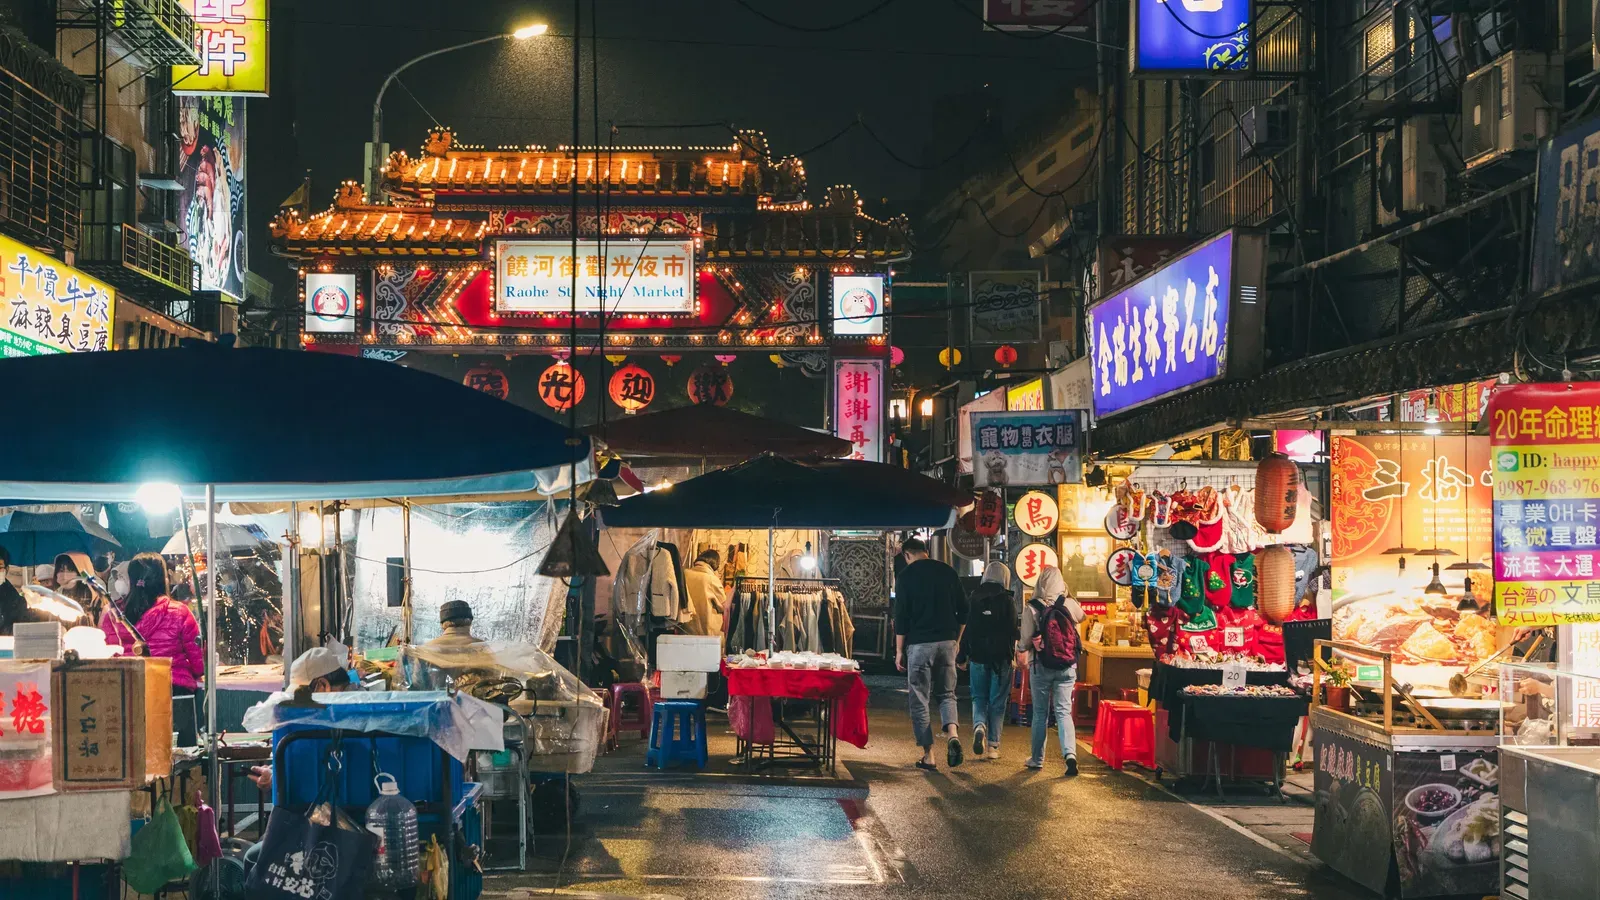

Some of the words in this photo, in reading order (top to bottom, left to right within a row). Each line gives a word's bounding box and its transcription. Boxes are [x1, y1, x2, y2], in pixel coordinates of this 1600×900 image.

[506, 255, 686, 278] 饒河街觀光夜市
[1111, 247, 1171, 286] 永
[9, 256, 109, 323] 平價牛排
[505, 285, 549, 298] Raohe
[585, 285, 622, 300] Night
[633, 285, 685, 298] Market
[9, 296, 108, 352] 麻辣臭豆腐
[541, 370, 572, 402] 光
[622, 372, 650, 402] 迎
[1523, 453, 1547, 468] ID:
[1498, 479, 1599, 496] 0987-968-976
[1026, 497, 1053, 531] 鳥
[1501, 502, 1597, 524] 專業OH卡
[1502, 526, 1597, 547] 紫微星盤
[1227, 671, 1240, 681] 20
[0, 684, 48, 735] 糖
